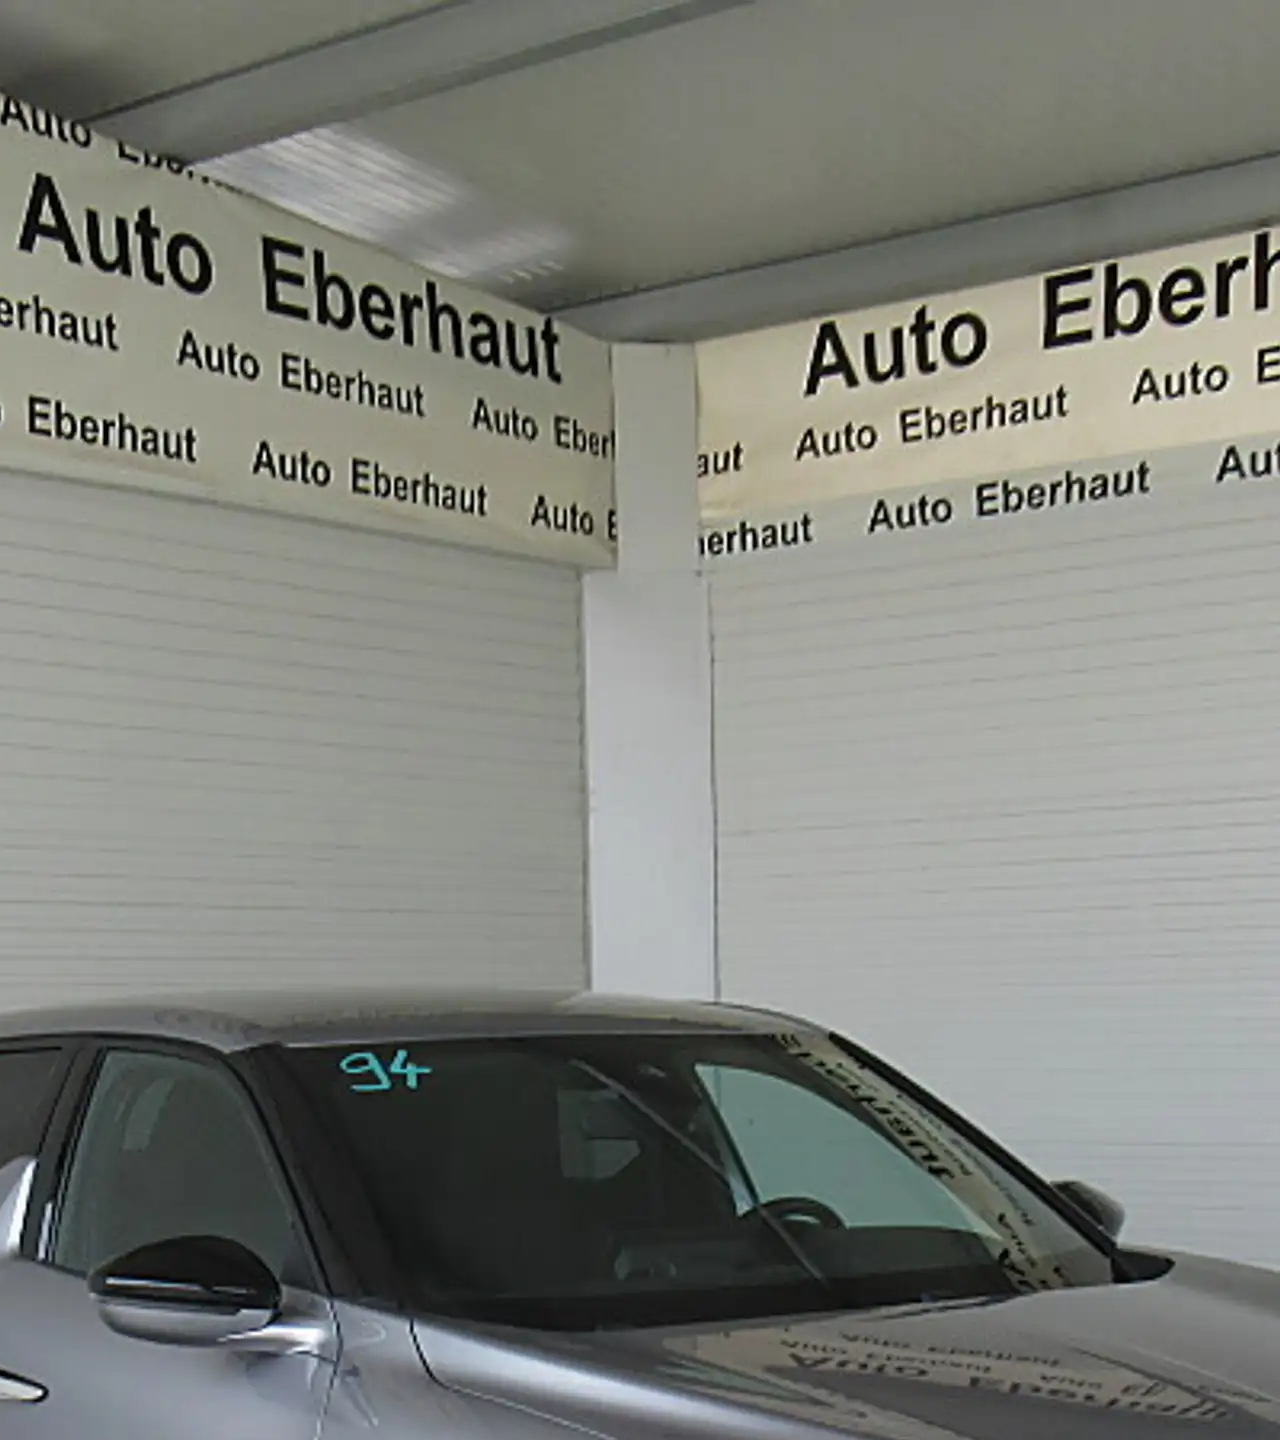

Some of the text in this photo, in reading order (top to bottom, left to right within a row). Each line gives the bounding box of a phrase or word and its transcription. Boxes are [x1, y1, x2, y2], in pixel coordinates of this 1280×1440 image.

[19, 173, 562, 384] Auto Eberhaut
[178, 330, 424, 417] Auto Eberhaut
[803, 306, 986, 396] Auto
[1133, 362, 1228, 404] Auto
[29, 396, 196, 463] Eberhaut
[473, 398, 538, 441] Auto
[797, 386, 1066, 460] Auto Eberhaut
[253, 441, 486, 516] Auto Eberhaut
[869, 461, 1149, 533] Auto Eberhaut
[532, 496, 593, 535] Auto
[339, 1049, 433, 1092] 94
